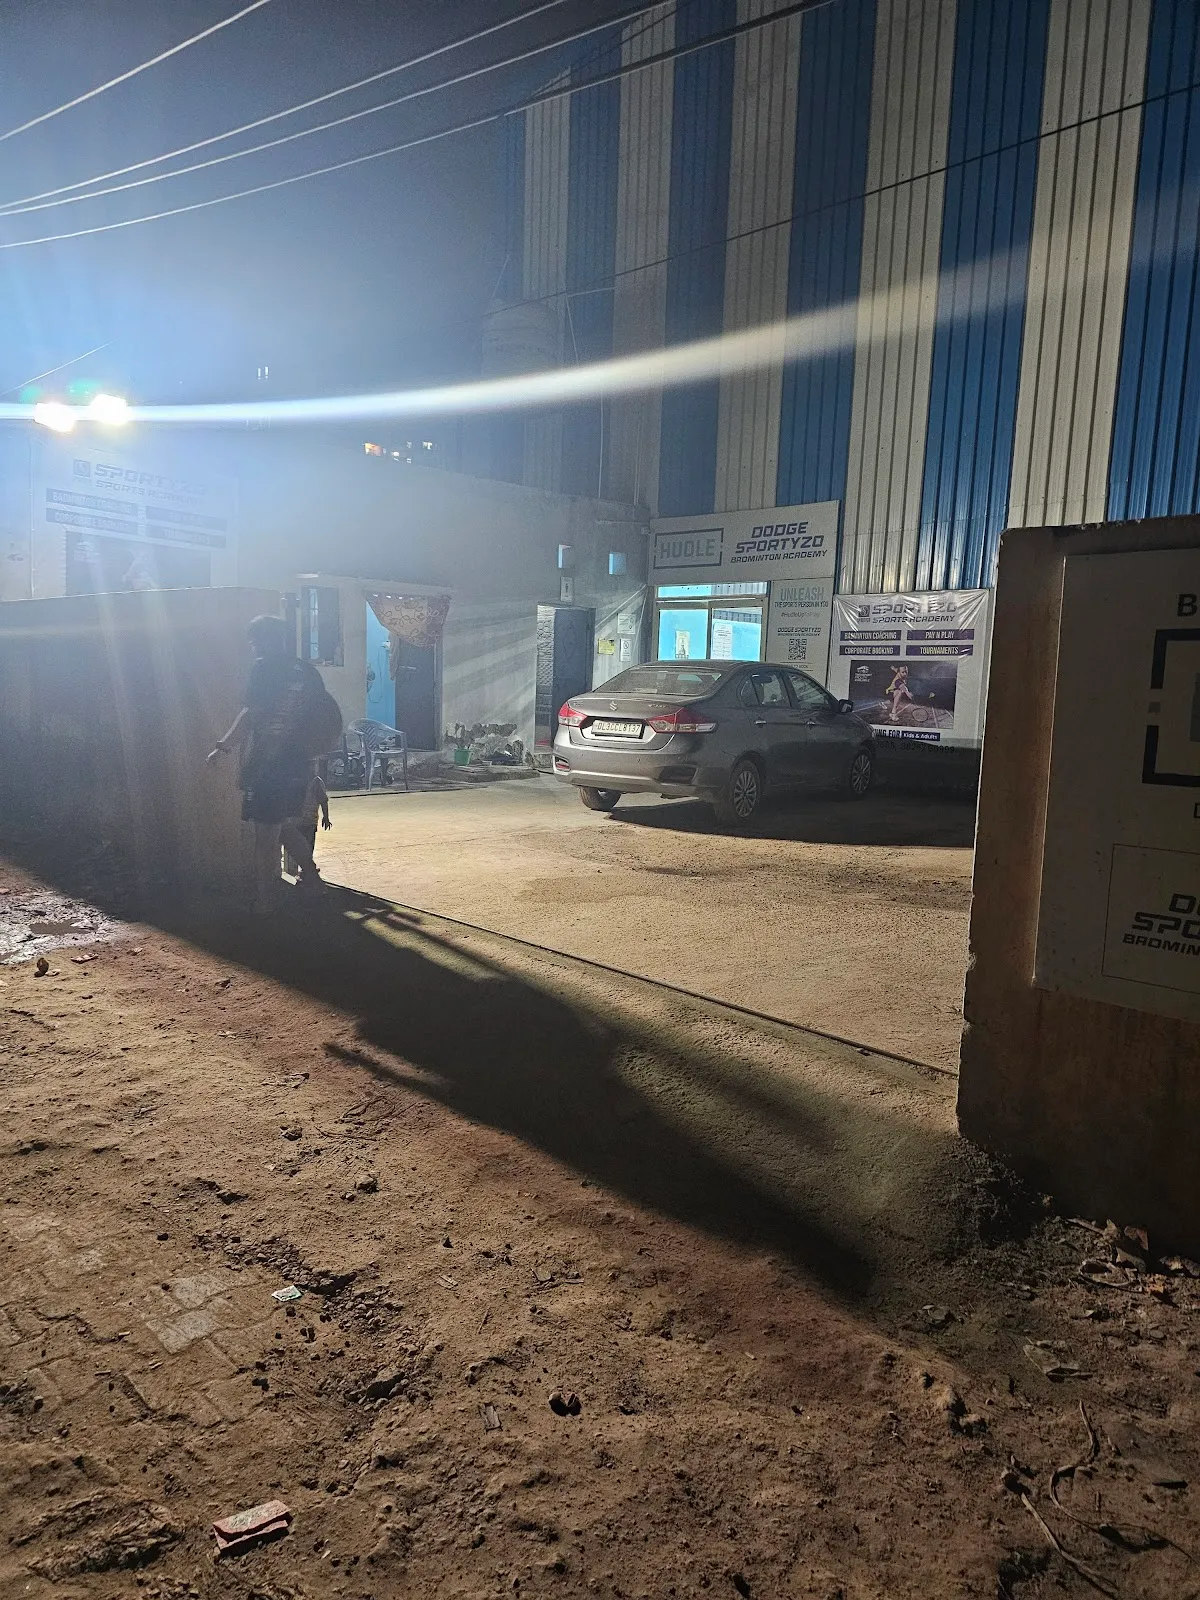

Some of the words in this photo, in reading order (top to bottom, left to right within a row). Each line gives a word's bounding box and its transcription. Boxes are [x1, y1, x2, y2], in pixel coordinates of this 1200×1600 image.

[96, 480, 146, 496] SPORTS
[751, 521, 809, 538] DODGE
[660, 538, 717, 560] HUDLE
[735, 535, 825, 554] SPORTYZO
[730, 553, 782, 563] BADMINTON
[783, 549, 828, 560] ACADEMY
[780, 586, 825, 601] UNLEASH
[872, 616, 907, 624] SPORTS
[909, 615, 956, 623] ACADEMY
[873, 631, 897, 640] COACHING
[925, 631, 935, 639] PAY
[941, 631, 955, 639] PLAY
[844, 646, 872, 655] CORPORATE
[872, 646, 894, 655] BOOKING
[920, 646, 959, 655] TOURNAMENTS
